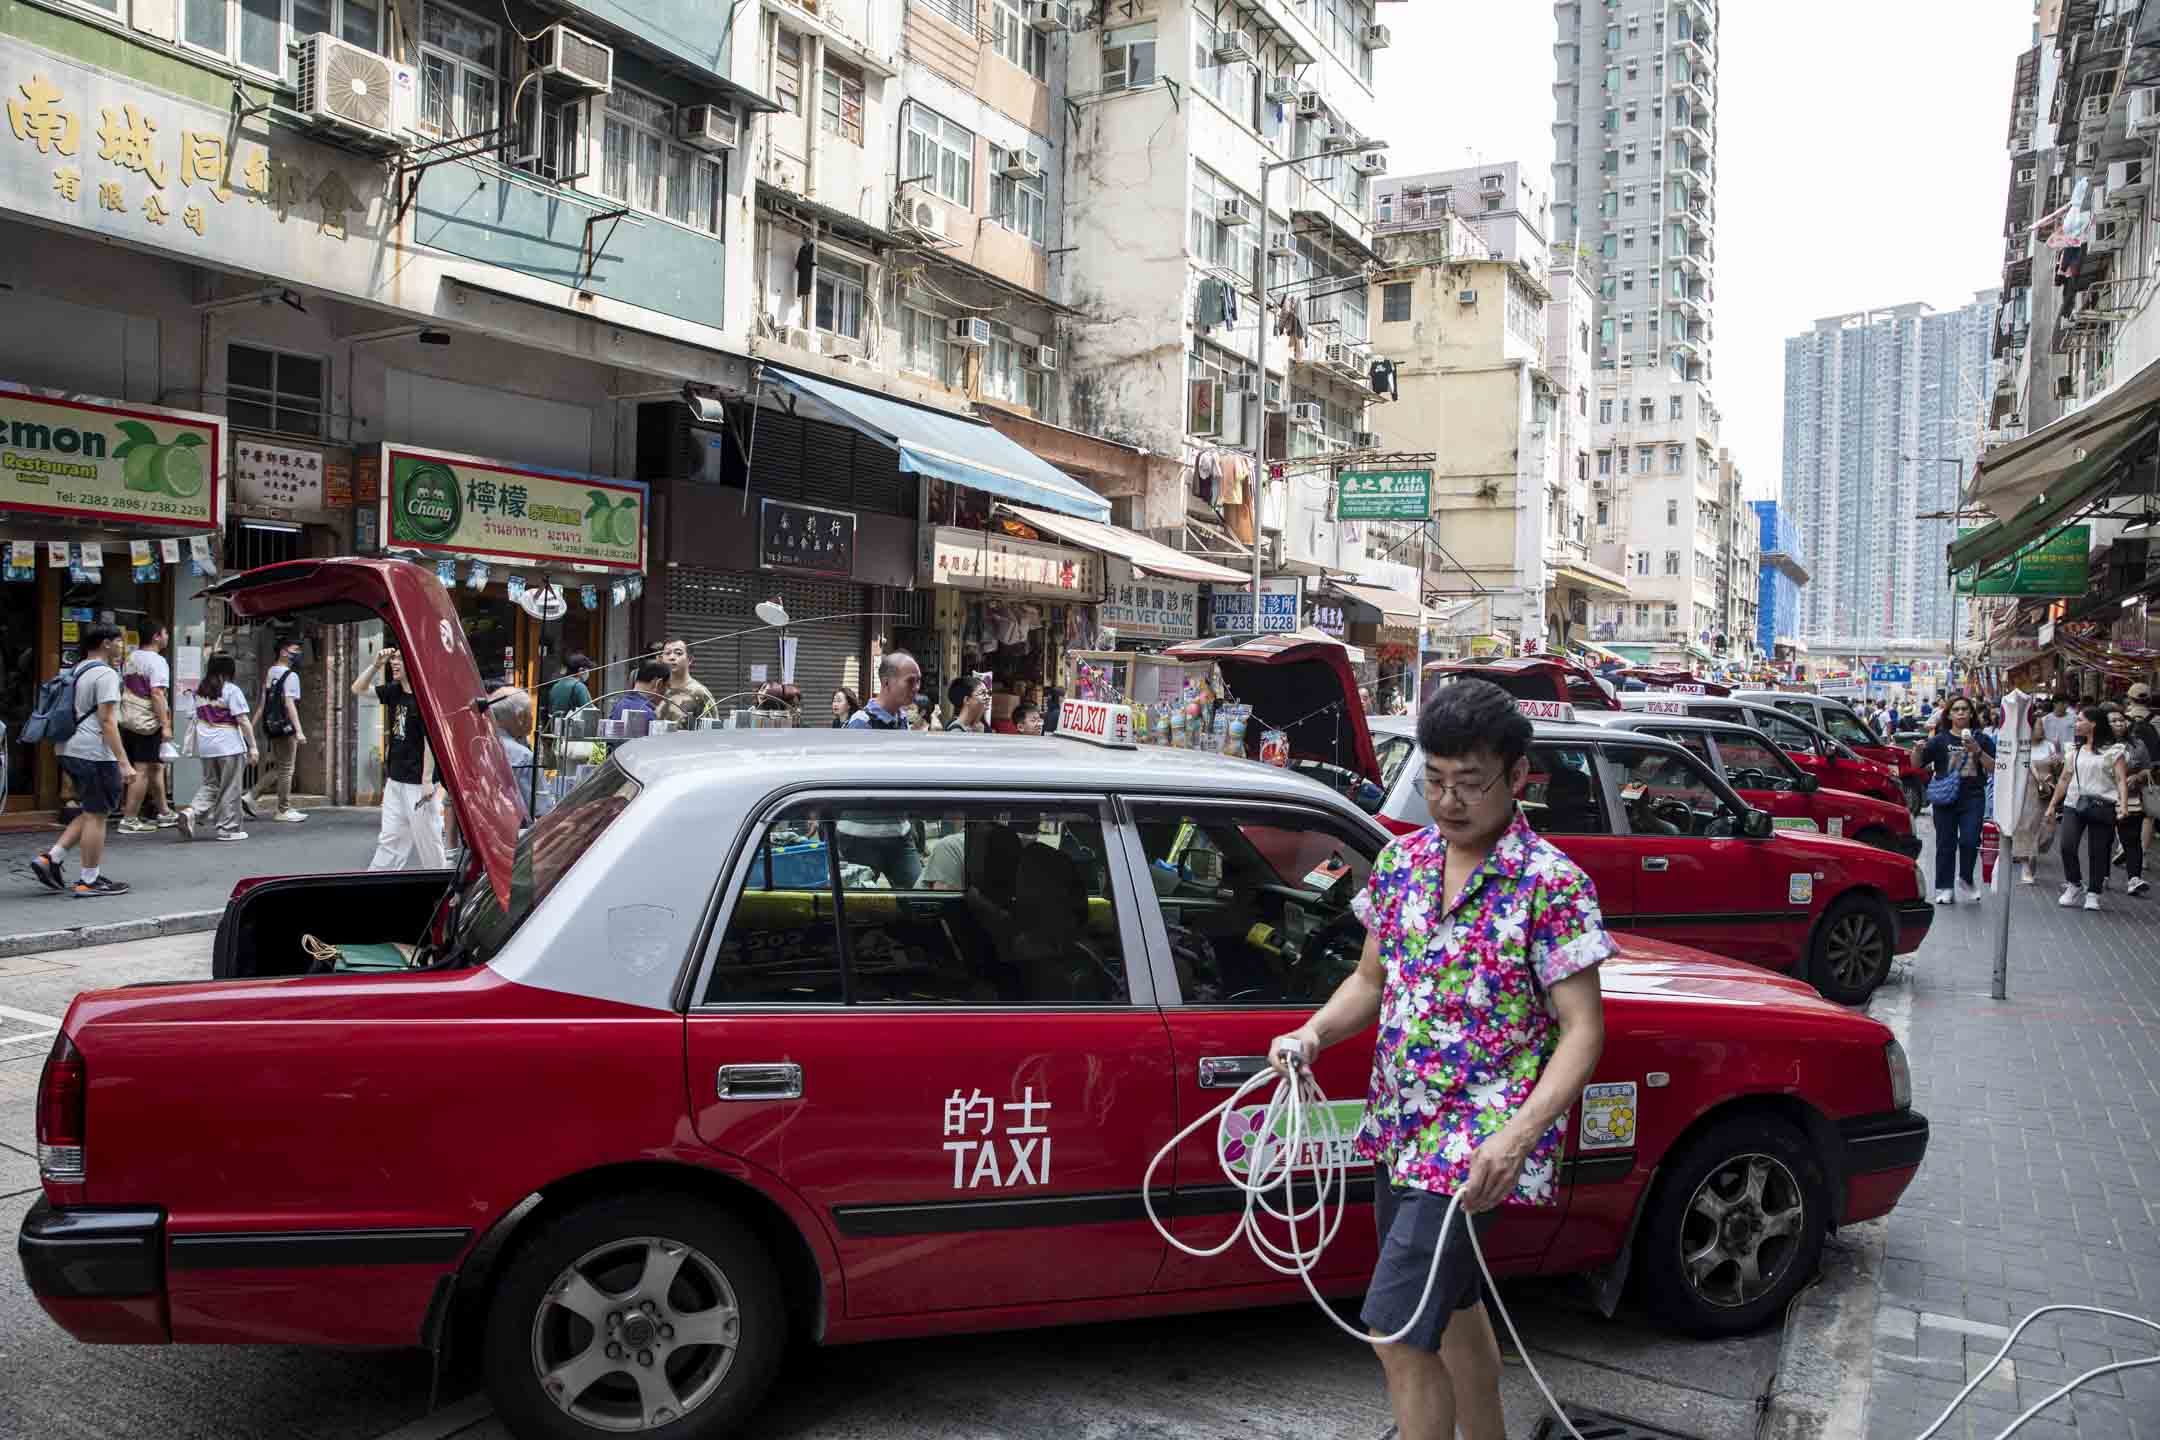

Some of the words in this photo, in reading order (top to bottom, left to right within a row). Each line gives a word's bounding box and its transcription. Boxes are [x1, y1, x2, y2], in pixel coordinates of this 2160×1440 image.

[53, 165, 207, 238] 有限公司
[2, 451, 97, 479] Restaurant
[56, 491, 76, 503] Tel:
[79, 494, 108, 505] 2382
[151, 502, 177, 513] 2382
[408, 499, 452, 521] Chang
[464, 478, 528, 518] 檸檬
[1136, 609, 1157, 624] VET
[1160, 610, 1192, 625] CLINIC
[1264, 616, 1293, 629] 0228
[1063, 703, 1106, 735] TAXI
[1520, 702, 1559, 717] TAXI
[1648, 702, 1679, 712] TAXI
[1115, 713, 1128, 737] 的士
[944, 1087, 1052, 1136] 的士
[943, 1138, 1052, 1189] TAXI
